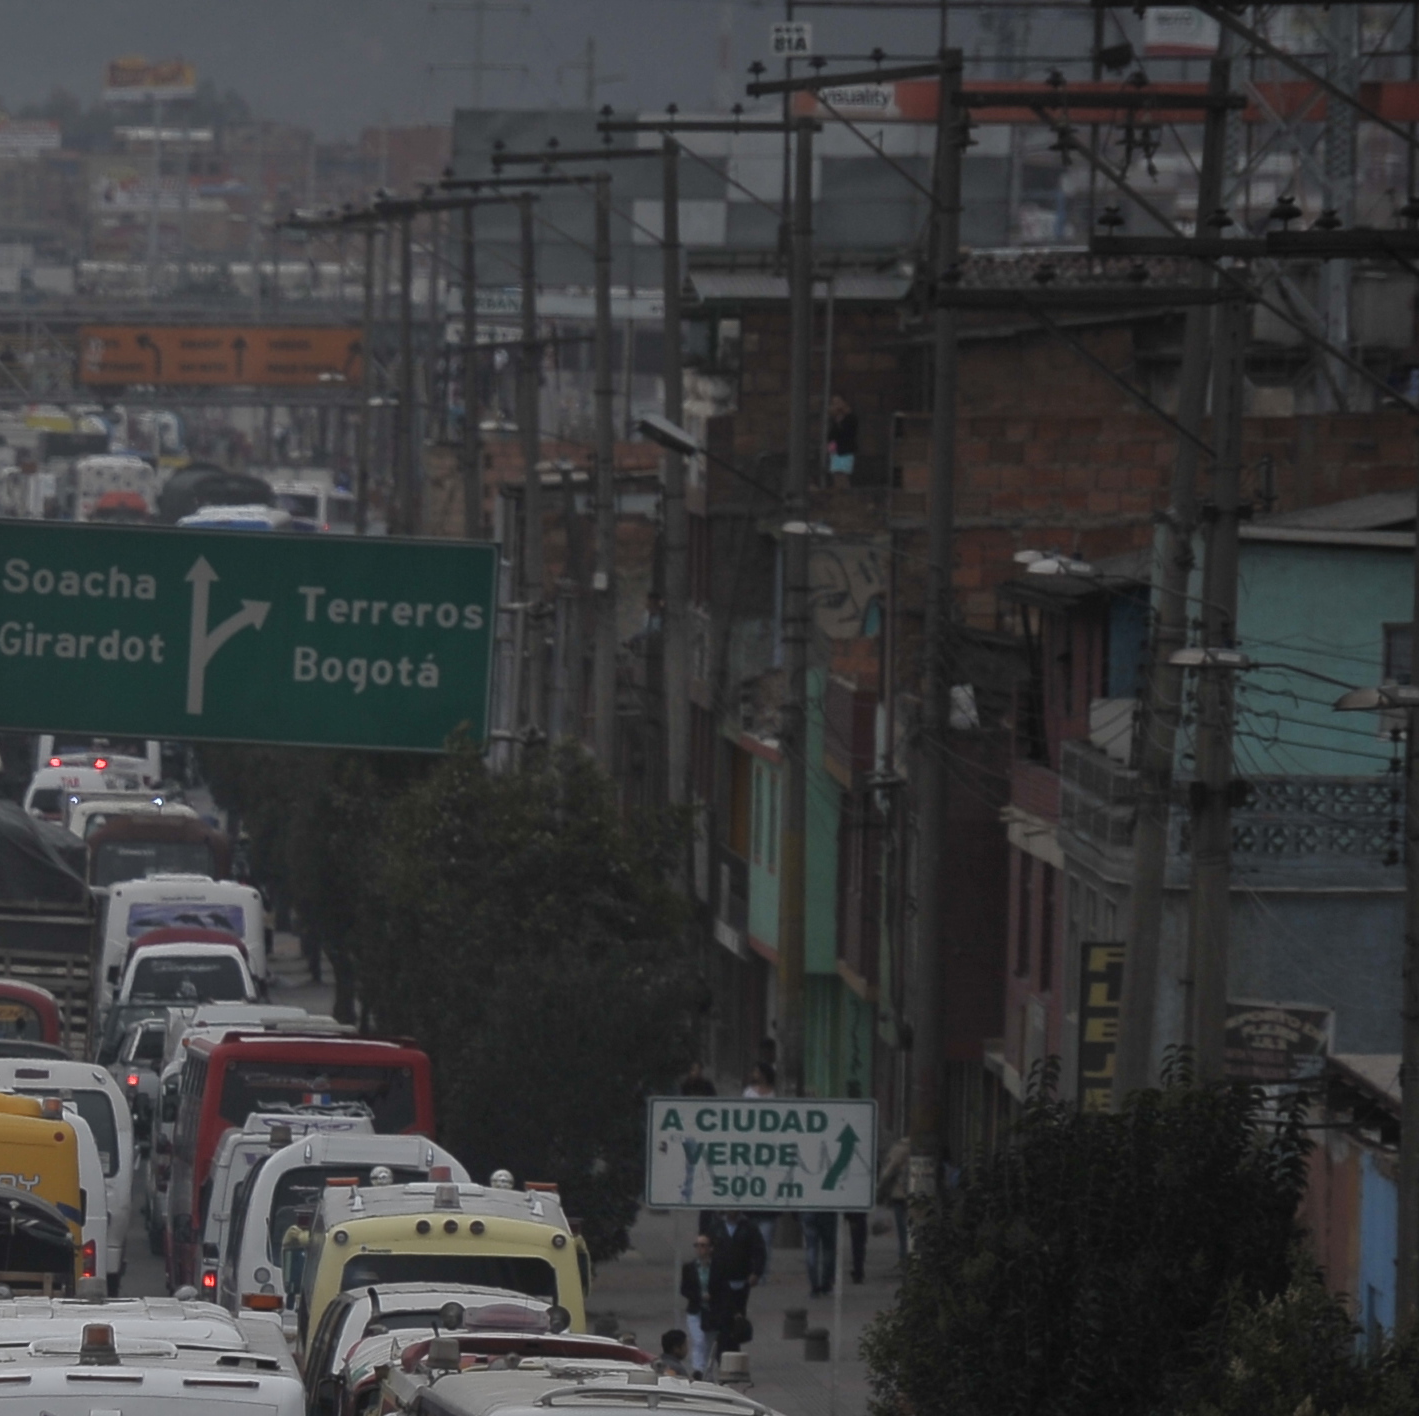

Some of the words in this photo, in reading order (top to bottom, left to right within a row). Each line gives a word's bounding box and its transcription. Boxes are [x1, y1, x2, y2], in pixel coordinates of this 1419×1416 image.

[1, 557, 157, 601] Soacha
[297, 585, 485, 631] Terreros
[292, 645, 440, 695] Bogotá
[660, 1108, 684, 1132] A
[695, 1108, 828, 1134] CIUDAD
[682, 1141, 799, 1167] VERDE
[712, 1175, 767, 1198] 500
[776, 1180, 804, 1198] m
